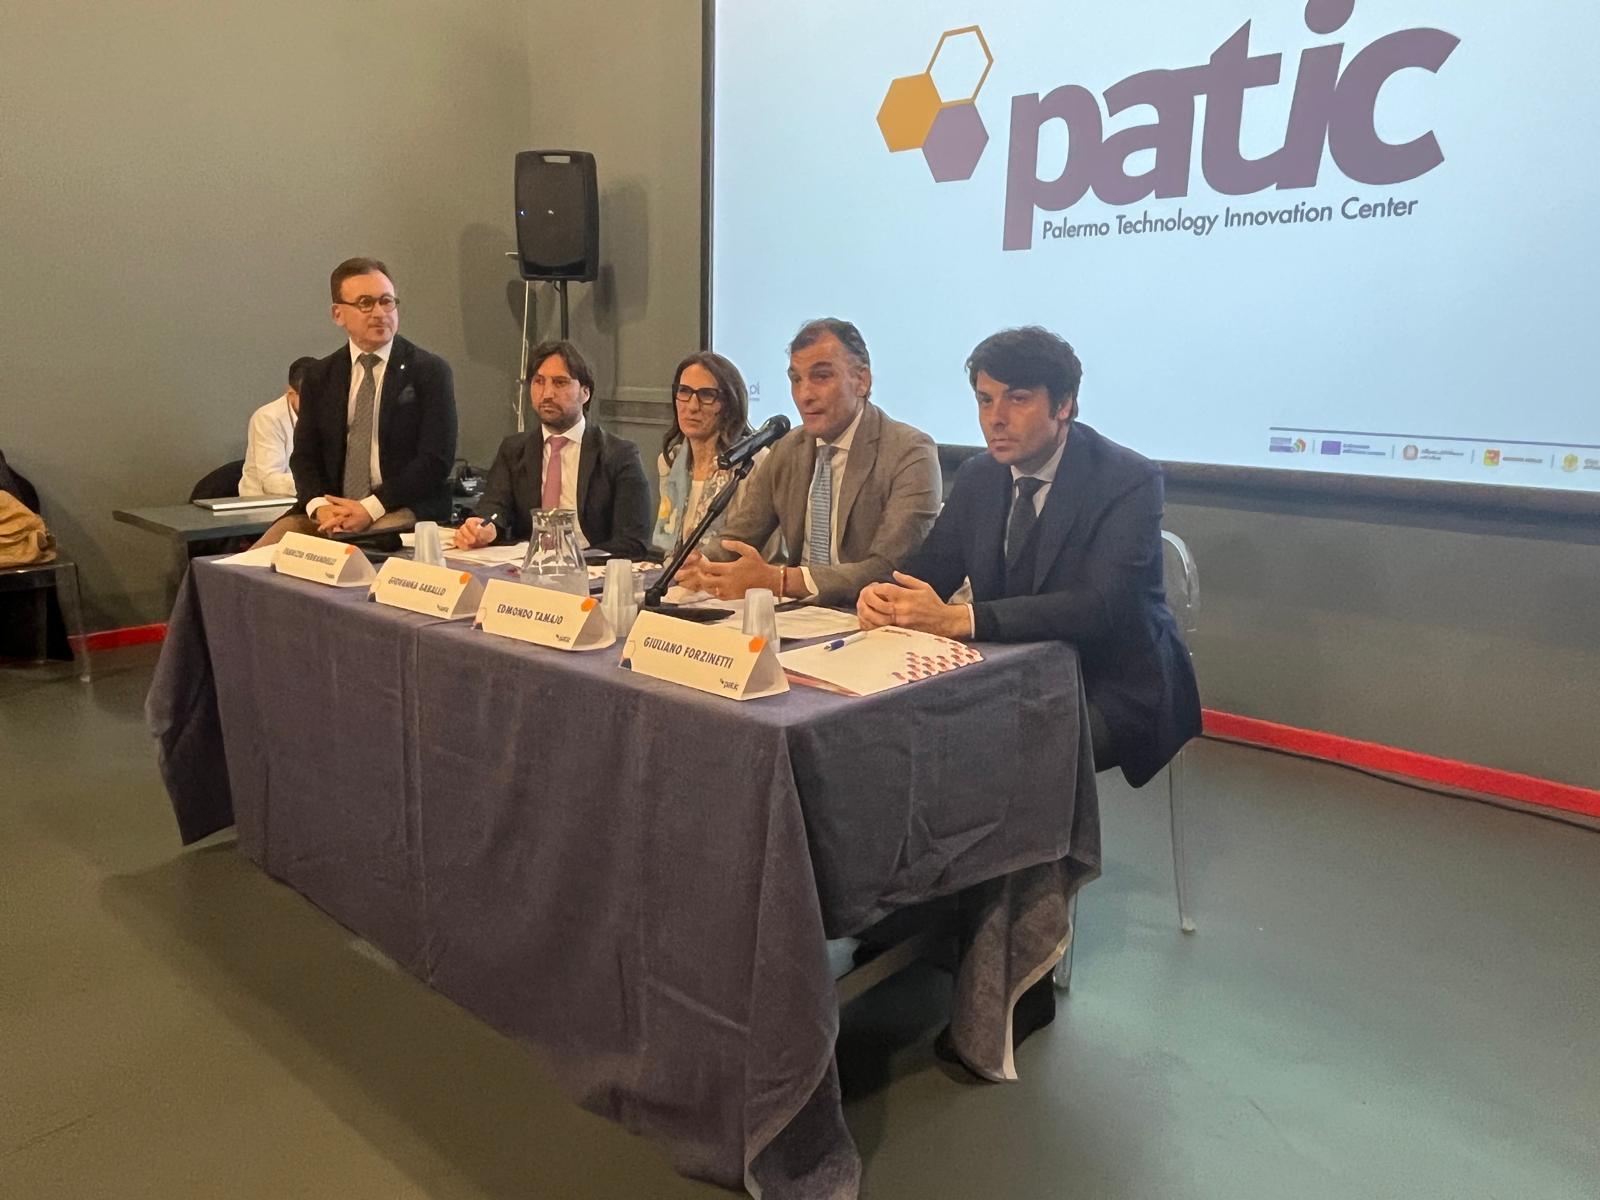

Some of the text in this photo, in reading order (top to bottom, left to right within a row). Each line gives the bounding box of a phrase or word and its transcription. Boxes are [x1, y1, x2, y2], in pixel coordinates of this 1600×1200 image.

[1003, 0, 1461, 251] patic
[1042, 196, 1419, 240] Palermo Technology Innovation Center
[497, 603, 533, 620] EDMONDO
[643, 636, 734, 669] GIULIANO FORZINETTI
